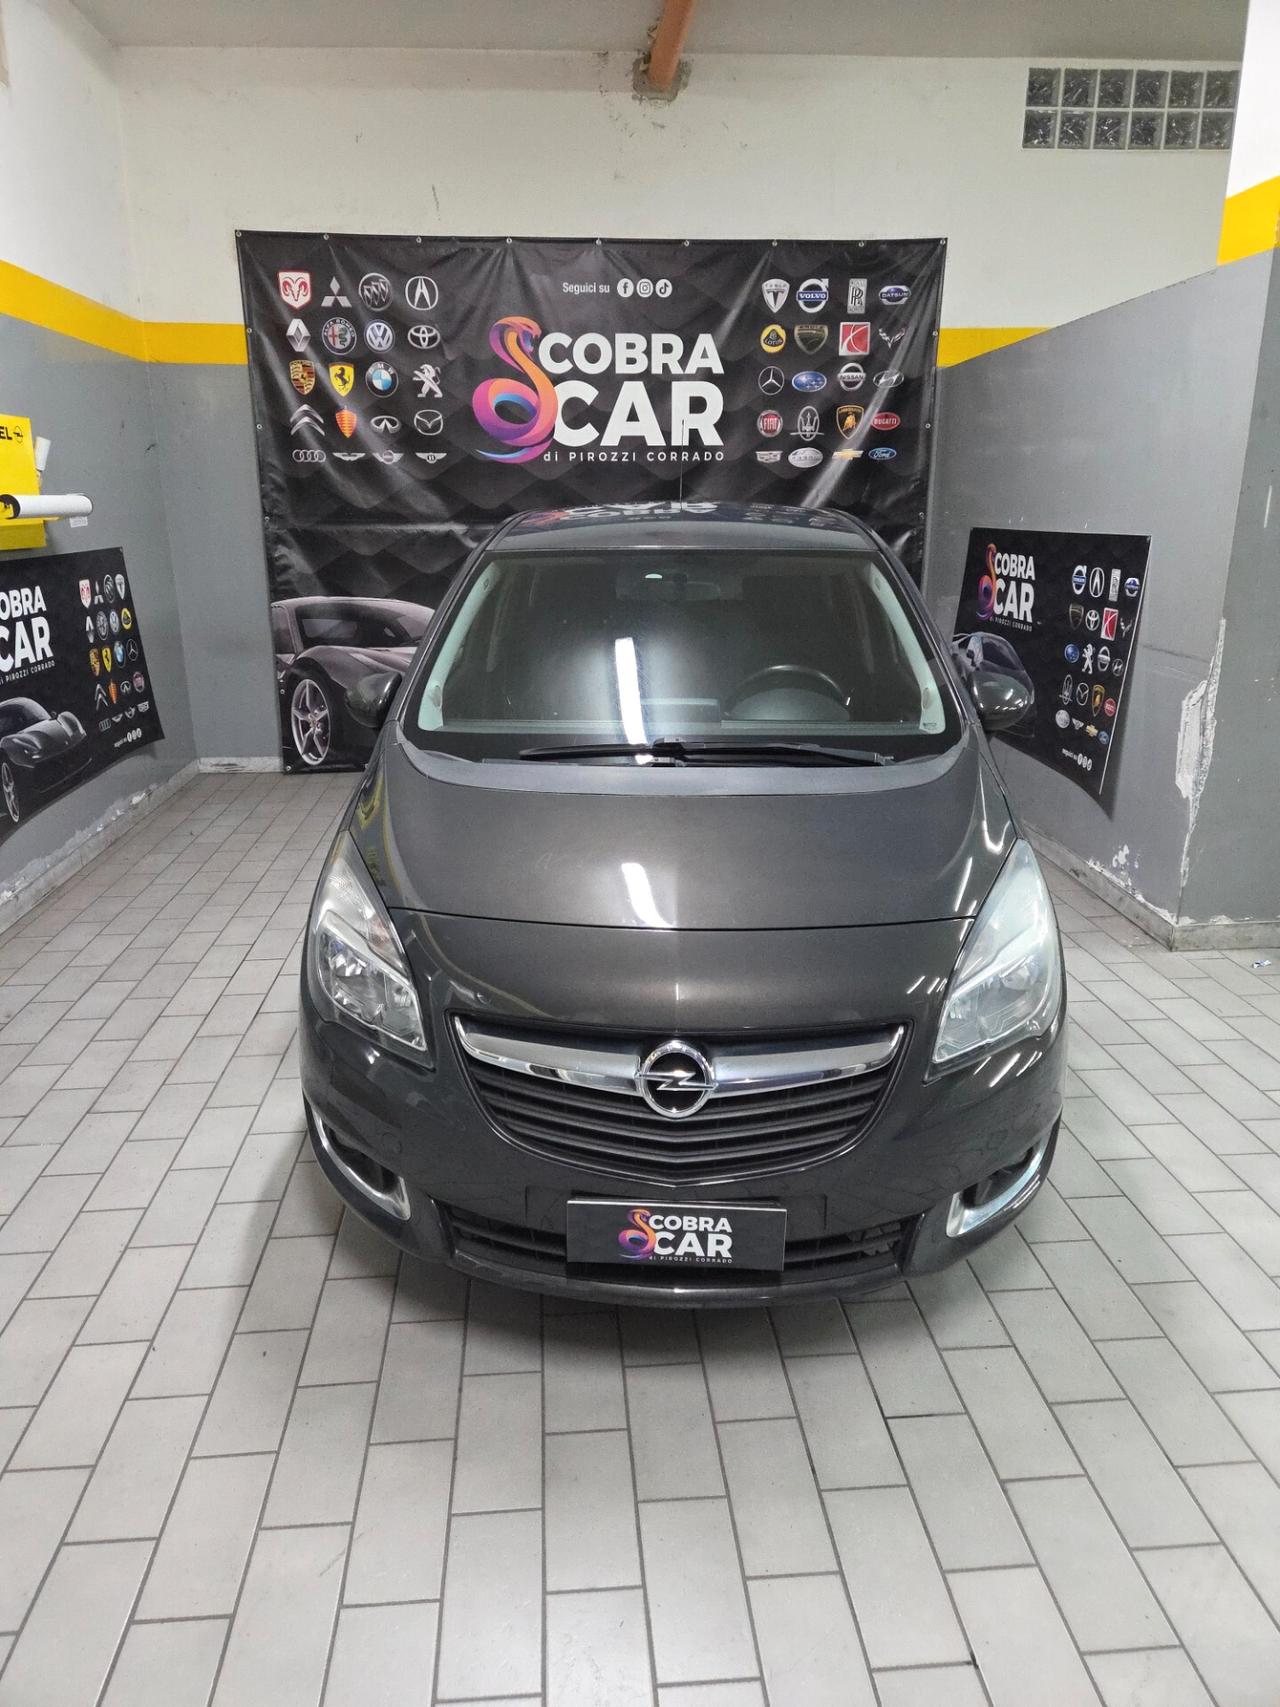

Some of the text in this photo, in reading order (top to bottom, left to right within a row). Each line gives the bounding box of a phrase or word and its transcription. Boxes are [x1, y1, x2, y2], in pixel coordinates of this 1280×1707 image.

[562, 281, 611, 295] Seguici su
[538, 332, 725, 375] COBRA
[553, 380, 725, 447] CAR
[873, 417, 897, 425] BUGATTI
[763, 417, 778, 430] FIAT
[543, 451, 725, 462] di PIROZZI CORRADO
[994, 552, 1036, 581] COBRA
[993, 578, 1034, 623] CAR
[30, 660, 56, 674] CORRADO
[648, 1214, 733, 1233] COBRA
[653, 1231, 733, 1258] CAR
